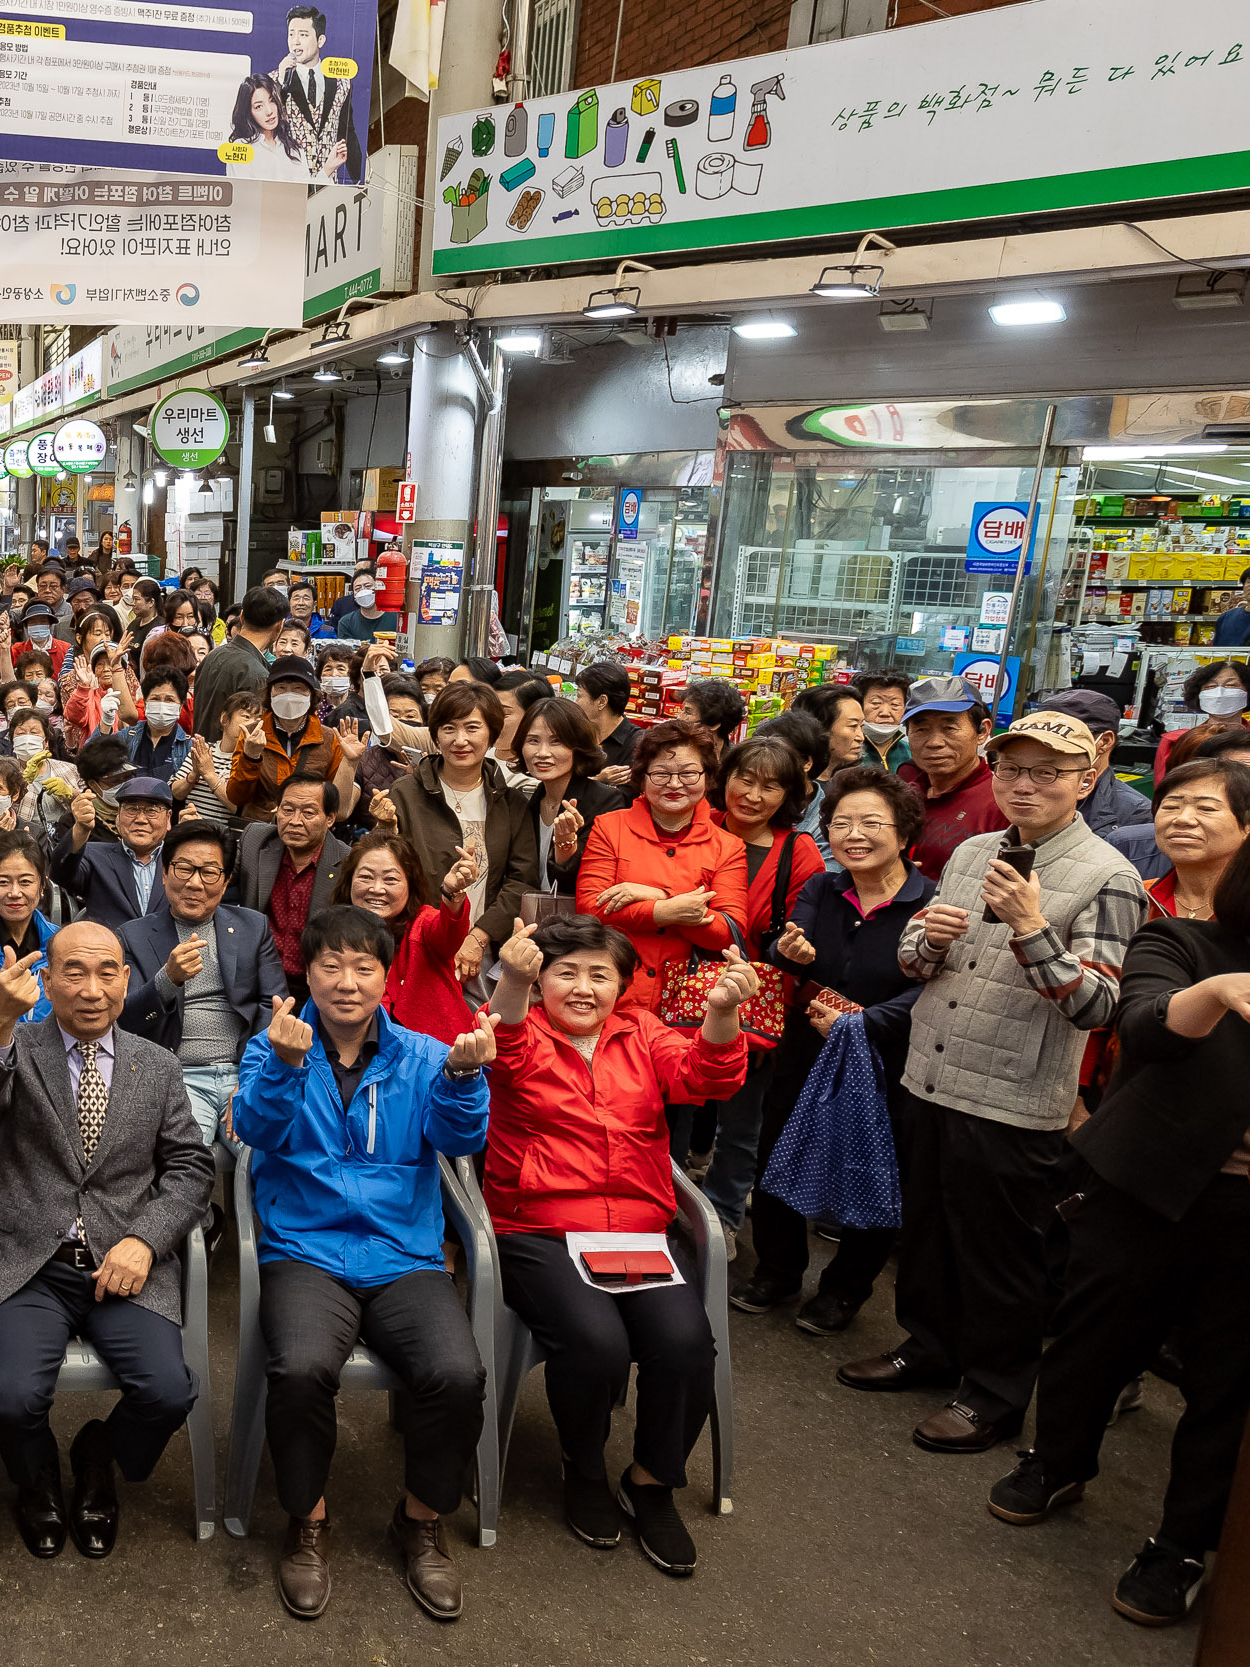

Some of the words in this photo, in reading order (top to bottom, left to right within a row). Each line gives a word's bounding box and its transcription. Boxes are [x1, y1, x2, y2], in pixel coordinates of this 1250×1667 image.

[34, 25, 60, 38] 이벤트
[831, 99, 906, 134] 상품의
[1033, 66, 1089, 103] 뭐든
[1107, 66, 1135, 82] 다
[162, 407, 219, 425] 우리마트
[176, 427, 204, 445] 생선
[181, 451, 199, 463] 생선
[983, 520, 1025, 539] 담배
